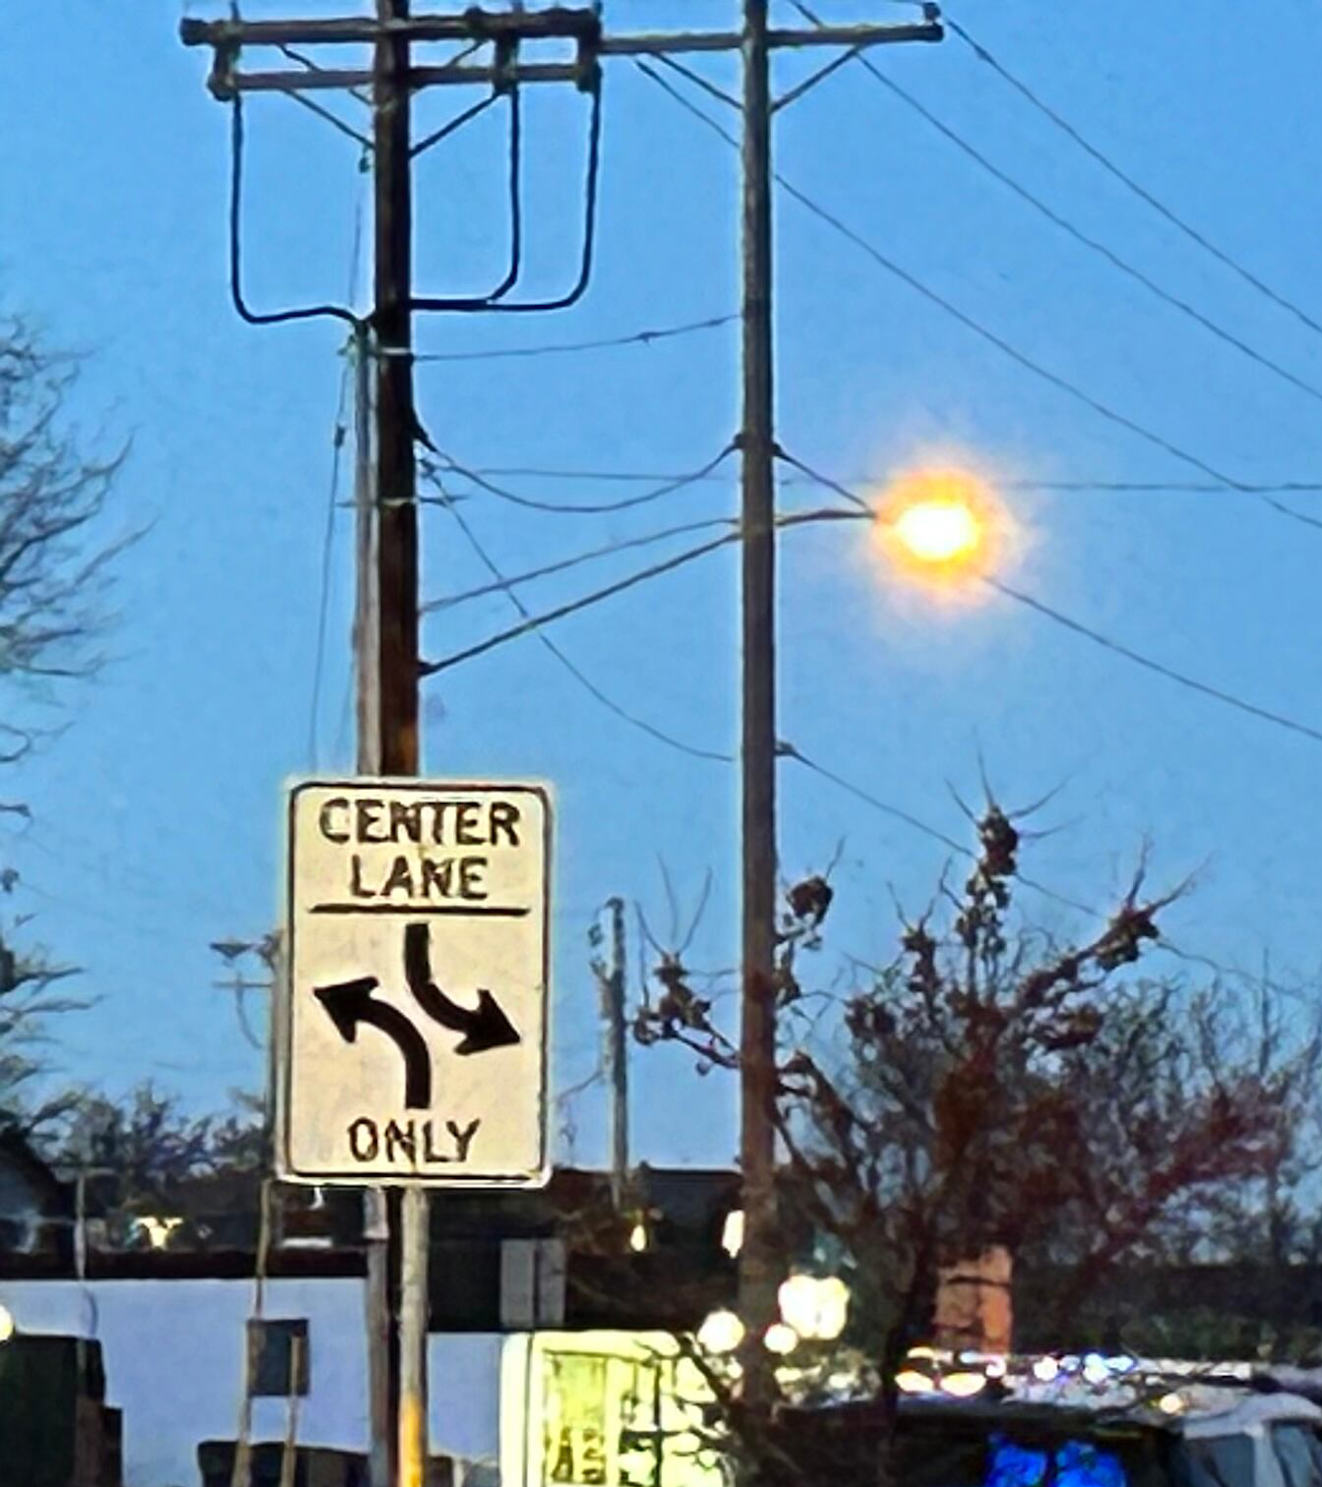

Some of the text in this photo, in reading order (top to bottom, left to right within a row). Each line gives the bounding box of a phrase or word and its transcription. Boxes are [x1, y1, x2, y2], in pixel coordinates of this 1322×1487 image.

[318, 797, 522, 847] CENTER
[350, 853, 490, 900] LANE
[347, 1116, 481, 1164] ONLY
